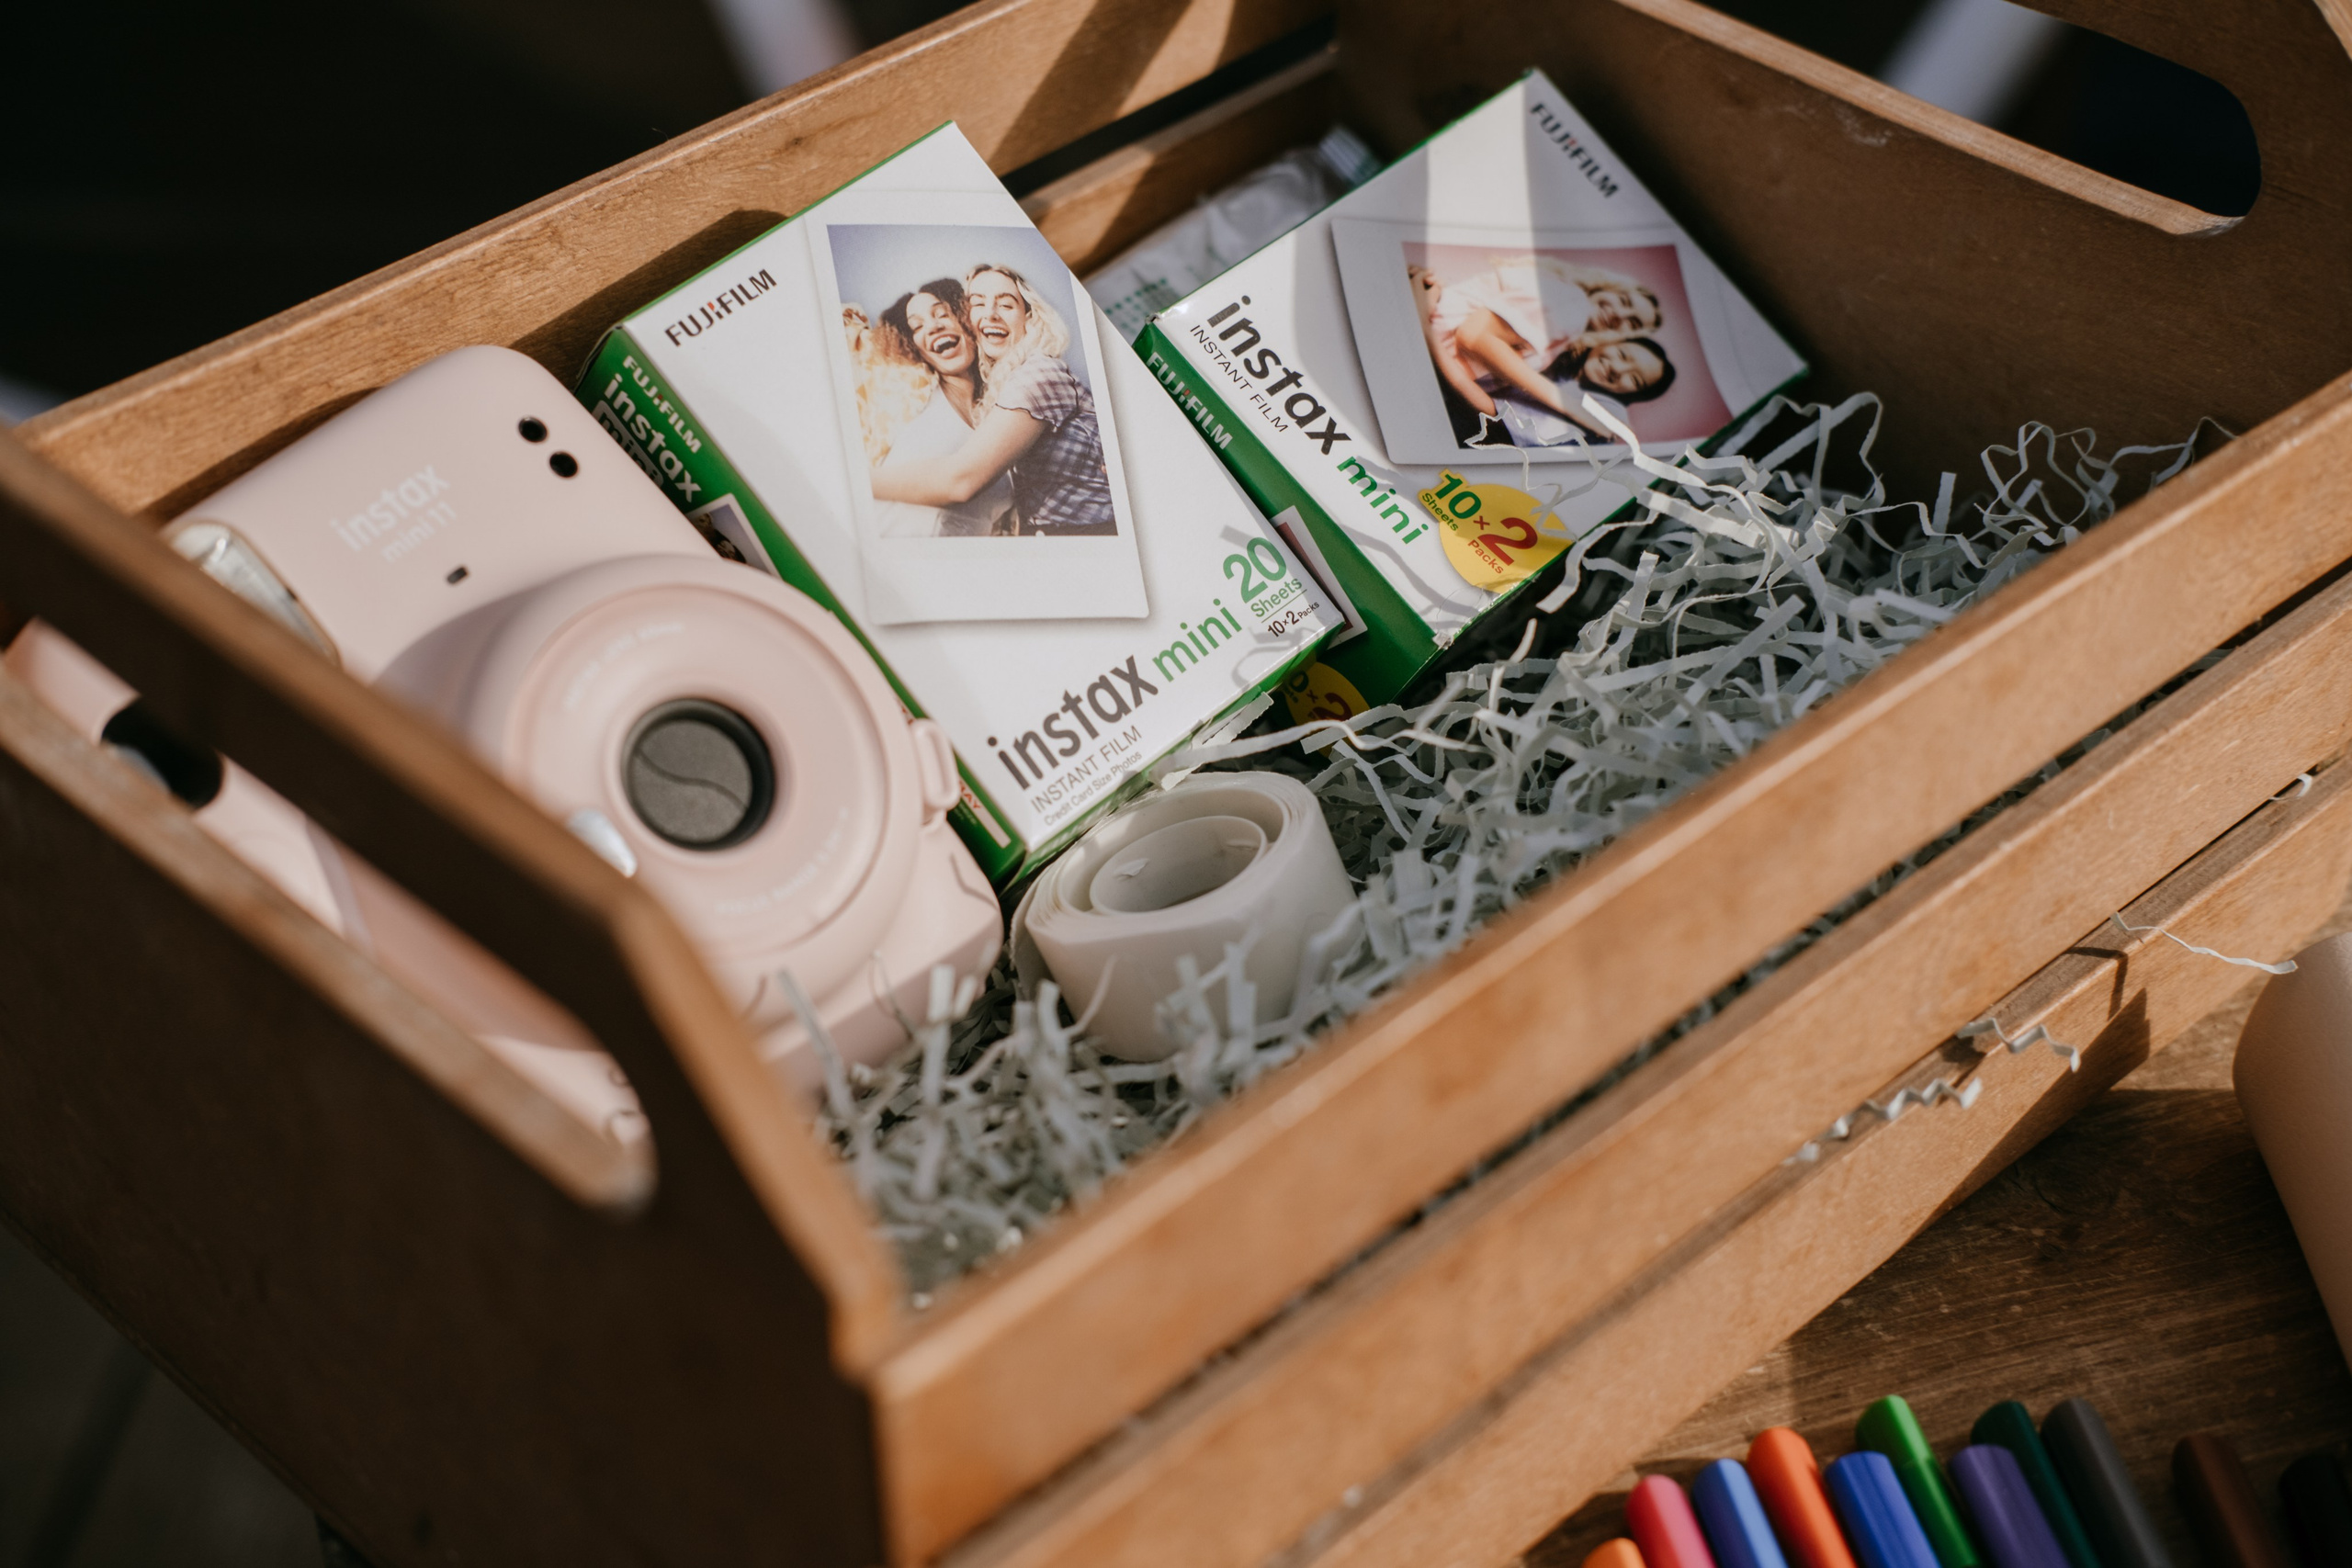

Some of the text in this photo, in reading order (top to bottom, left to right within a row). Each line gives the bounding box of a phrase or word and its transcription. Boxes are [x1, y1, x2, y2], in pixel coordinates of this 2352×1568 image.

[1530, 101, 1620, 198] FUJIFILM
[664, 268, 778, 347] FUJIFILM
[622, 355, 703, 454] FUJIFILM
[1145, 350, 1234, 451] FUJIFILM
[1190, 323, 1290, 434] INSTANT FILM
[1206, 294, 1430, 546] instax mini
[604, 373, 702, 503] instax
[328, 464, 451, 552] instax
[380, 500, 457, 564] mini 11
[1422, 492, 1459, 532] Sheets
[1223, 537, 1287, 604] 20
[1250, 578, 1303, 617] Sheets
[1467, 539, 1504, 574] Packs
[1297, 602, 1320, 618] Packs
[987, 598, 1243, 791] instax mini
[1031, 725, 1142, 813] INSTANT FILM
[1044, 751, 1143, 826] Credit Card Size Photos
